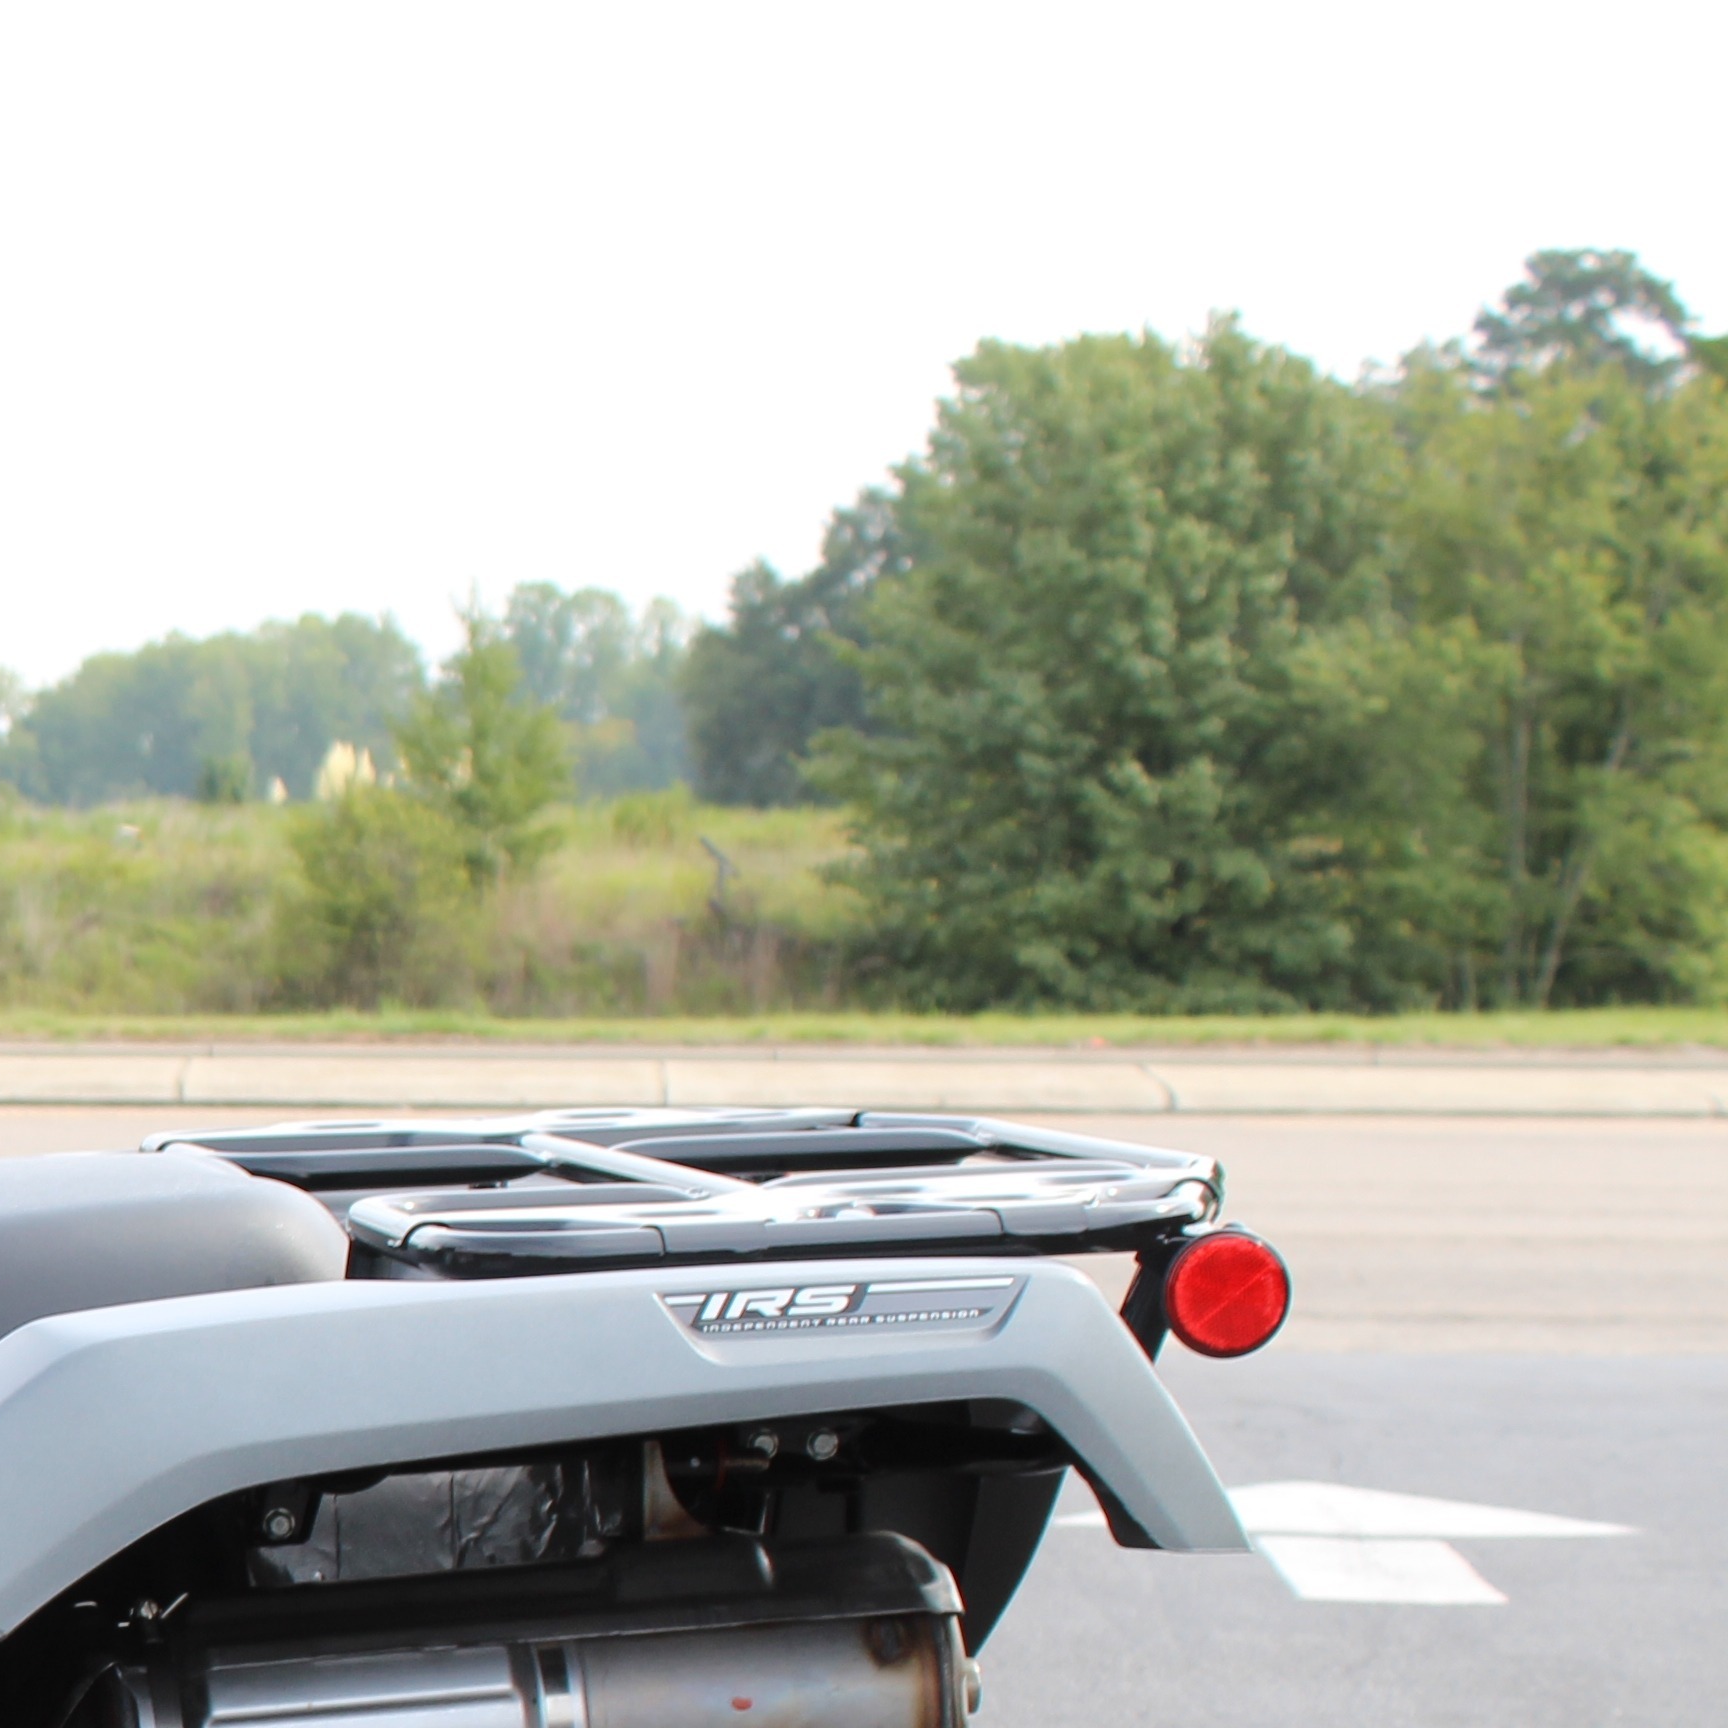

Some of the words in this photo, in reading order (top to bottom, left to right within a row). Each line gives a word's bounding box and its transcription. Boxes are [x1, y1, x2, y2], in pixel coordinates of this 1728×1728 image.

[700, 1284, 857, 1321] IRS
[702, 1318, 822, 1333] INDEPENDENT
[825, 1315, 871, 1326] REAR
[875, 1309, 979, 1323] SUSPENSION
